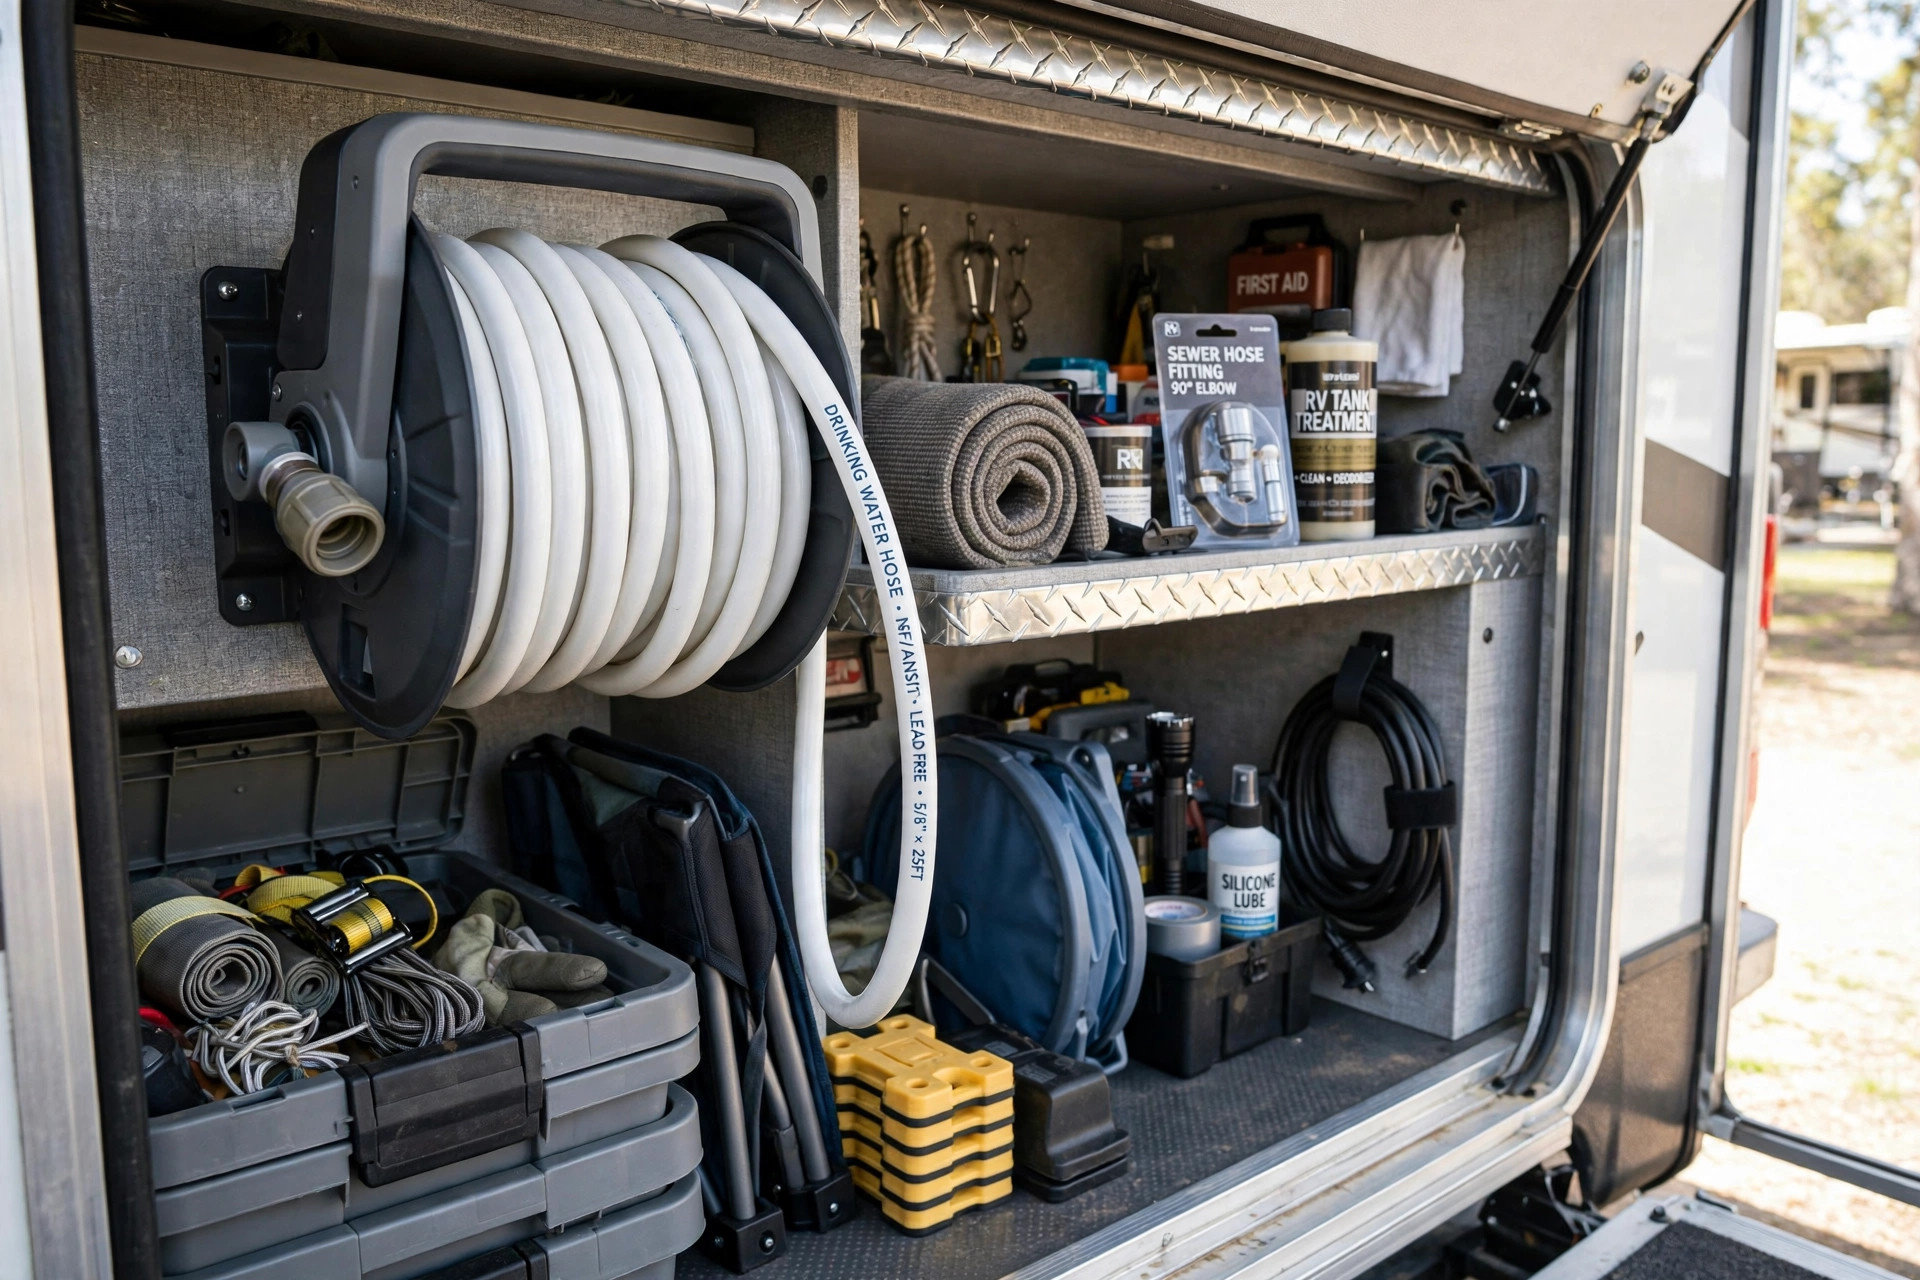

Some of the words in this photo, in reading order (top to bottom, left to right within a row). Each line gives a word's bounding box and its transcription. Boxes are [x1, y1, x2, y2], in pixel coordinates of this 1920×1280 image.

[1237, 273, 1279, 295] FIRST
[1281, 271, 1309, 293] AID
[1167, 345, 1221, 362] SEWER
[1223, 345, 1264, 362] HOSE
[1168, 363, 1223, 379] FITTING
[1195, 381, 1237, 395] ELBOW
[1305, 389, 1328, 411] RV
[1330, 389, 1369, 411] TANK
[1296, 411, 1376, 432] TREATMENT
[824, 404, 868, 482] DRINKING
[1300, 472, 1325, 484] CLEAN
[860, 485, 889, 545] WATER
[879, 549, 904, 598] HOSE
[910, 710, 925, 750] LEAD
[911, 849, 925, 881] 25FT
[1222, 873, 1275, 891] SILICONE
[1234, 892, 1265, 908] LUBE
